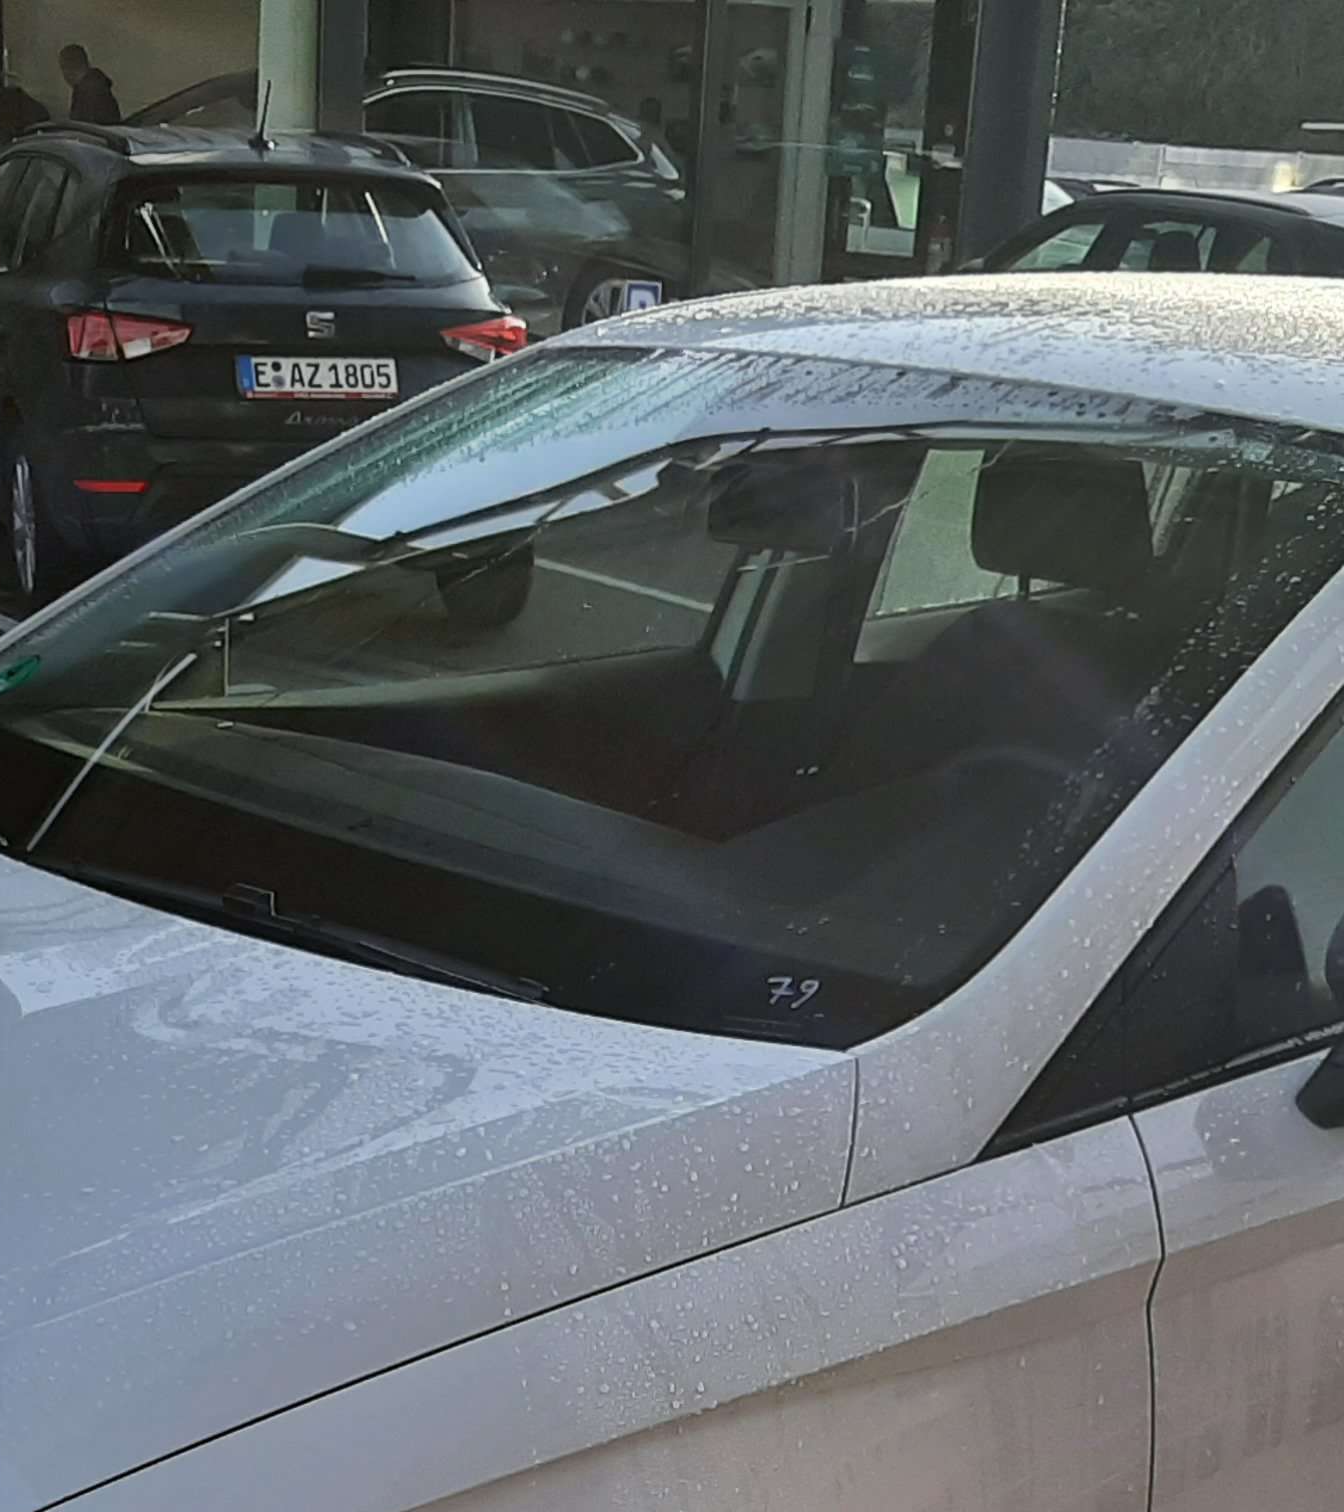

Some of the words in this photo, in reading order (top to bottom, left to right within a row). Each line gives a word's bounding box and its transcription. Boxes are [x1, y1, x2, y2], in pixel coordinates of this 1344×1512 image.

[254, 362, 271, 388] E
[290, 362, 323, 389] AZ
[328, 363, 392, 389] 1805
[767, 977, 820, 1009] 79
